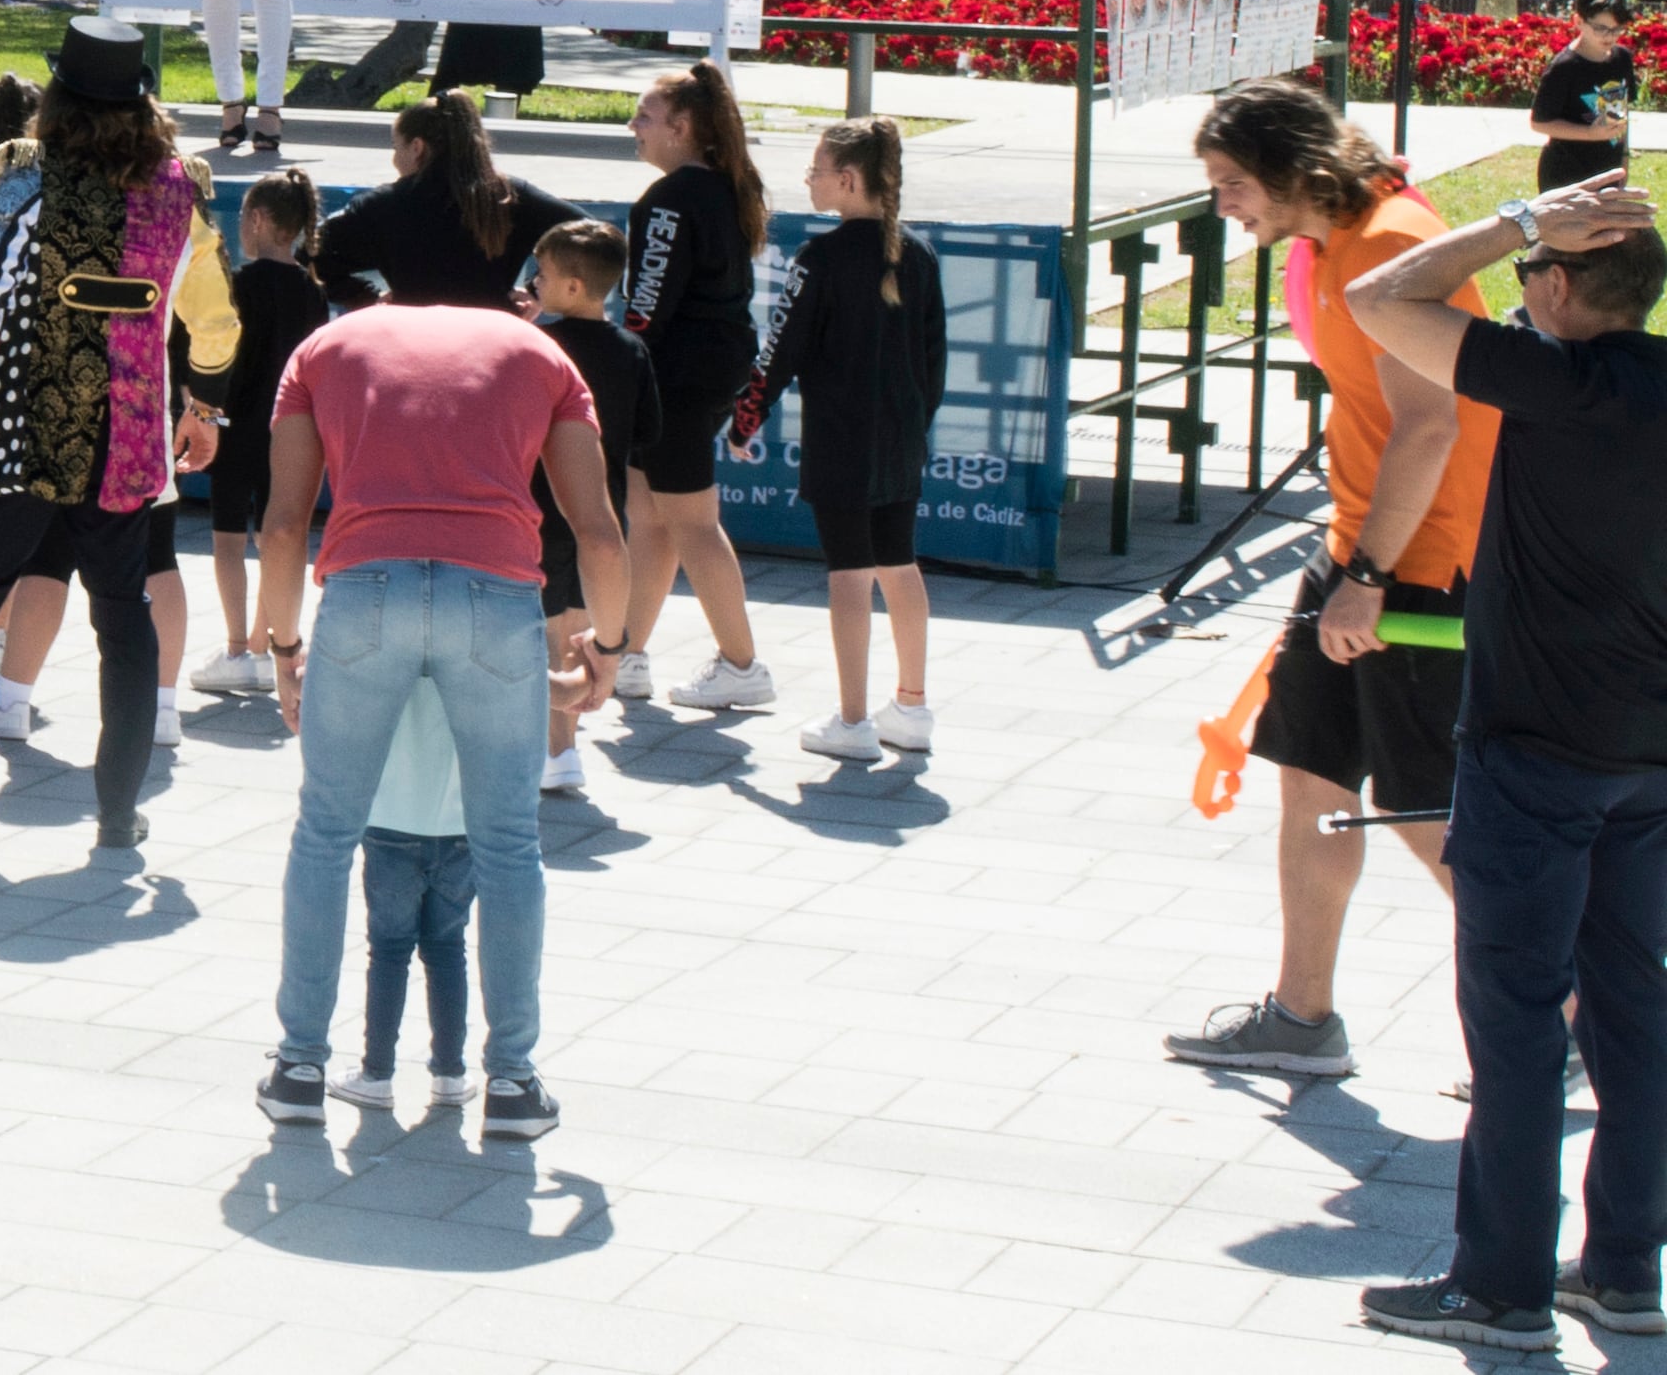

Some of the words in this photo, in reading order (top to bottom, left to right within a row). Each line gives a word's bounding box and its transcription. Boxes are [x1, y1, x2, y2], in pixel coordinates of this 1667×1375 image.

[631, 207, 680, 321] HEADWAY
[785, 490, 799, 507] 7
[937, 502, 965, 519] de
[973, 504, 1024, 525] Cádiz
